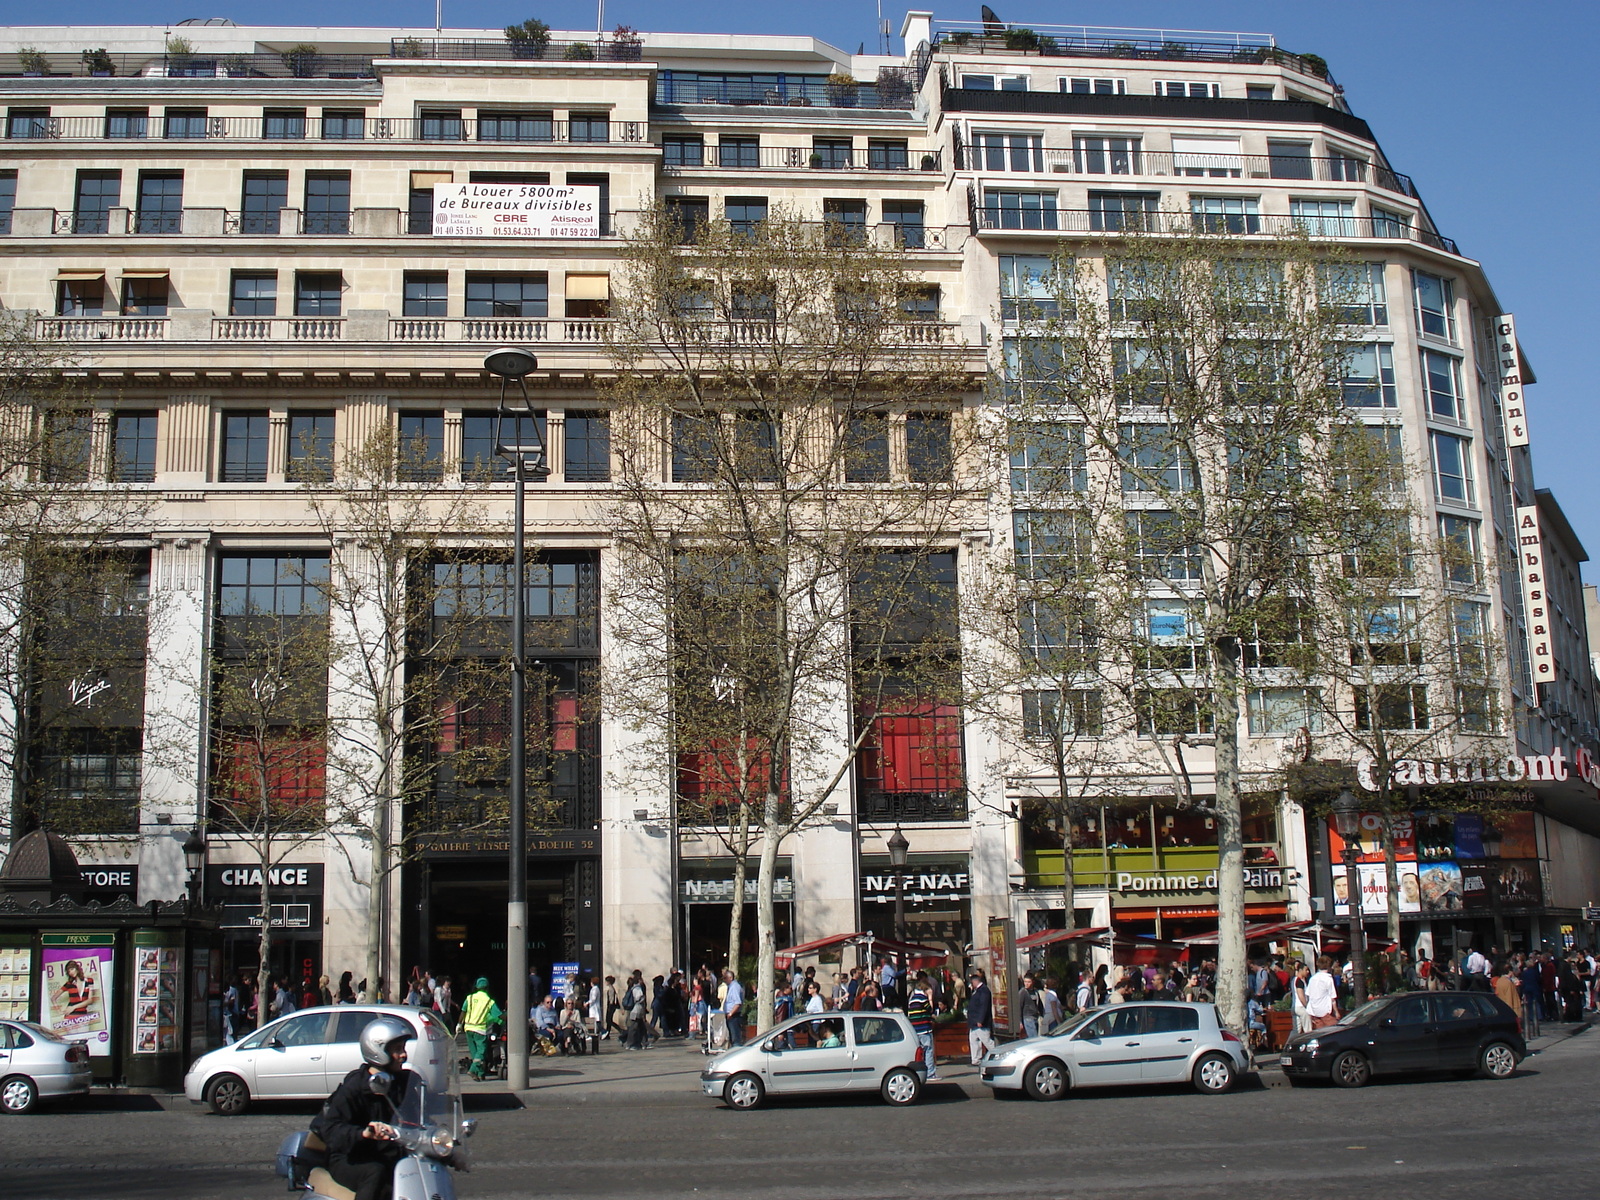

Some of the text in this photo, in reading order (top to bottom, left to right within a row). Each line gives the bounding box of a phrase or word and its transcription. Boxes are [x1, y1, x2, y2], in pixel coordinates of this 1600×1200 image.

[458, 186, 468, 196] A
[473, 186, 513, 197] Louer
[439, 198, 593, 211] de Bureaux divisibles
[493, 214, 528, 223] CBRE
[435, 226, 483, 235] 01 40 55 15 15
[493, 227, 541, 236] 01.53.64.33.71
[550, 227, 598, 237] 01 47 59 22 20
[1497, 322, 1525, 438] Gaumont
[1521, 514, 1550, 675] Ambassade
[68, 669, 111, 708] Virgin
[1357, 746, 1568, 792] Gaumont
[1361, 814, 1412, 831] OS
[581, 840, 594, 849] 52
[221, 868, 308, 886] CHANGE
[866, 873, 968, 891] NAF NAF
[1117, 872, 1199, 892] Pomme
[1205, 869, 1220, 888] d
[1363, 885, 1402, 894] DOUBLE
[1055, 899, 1066, 907] 50
